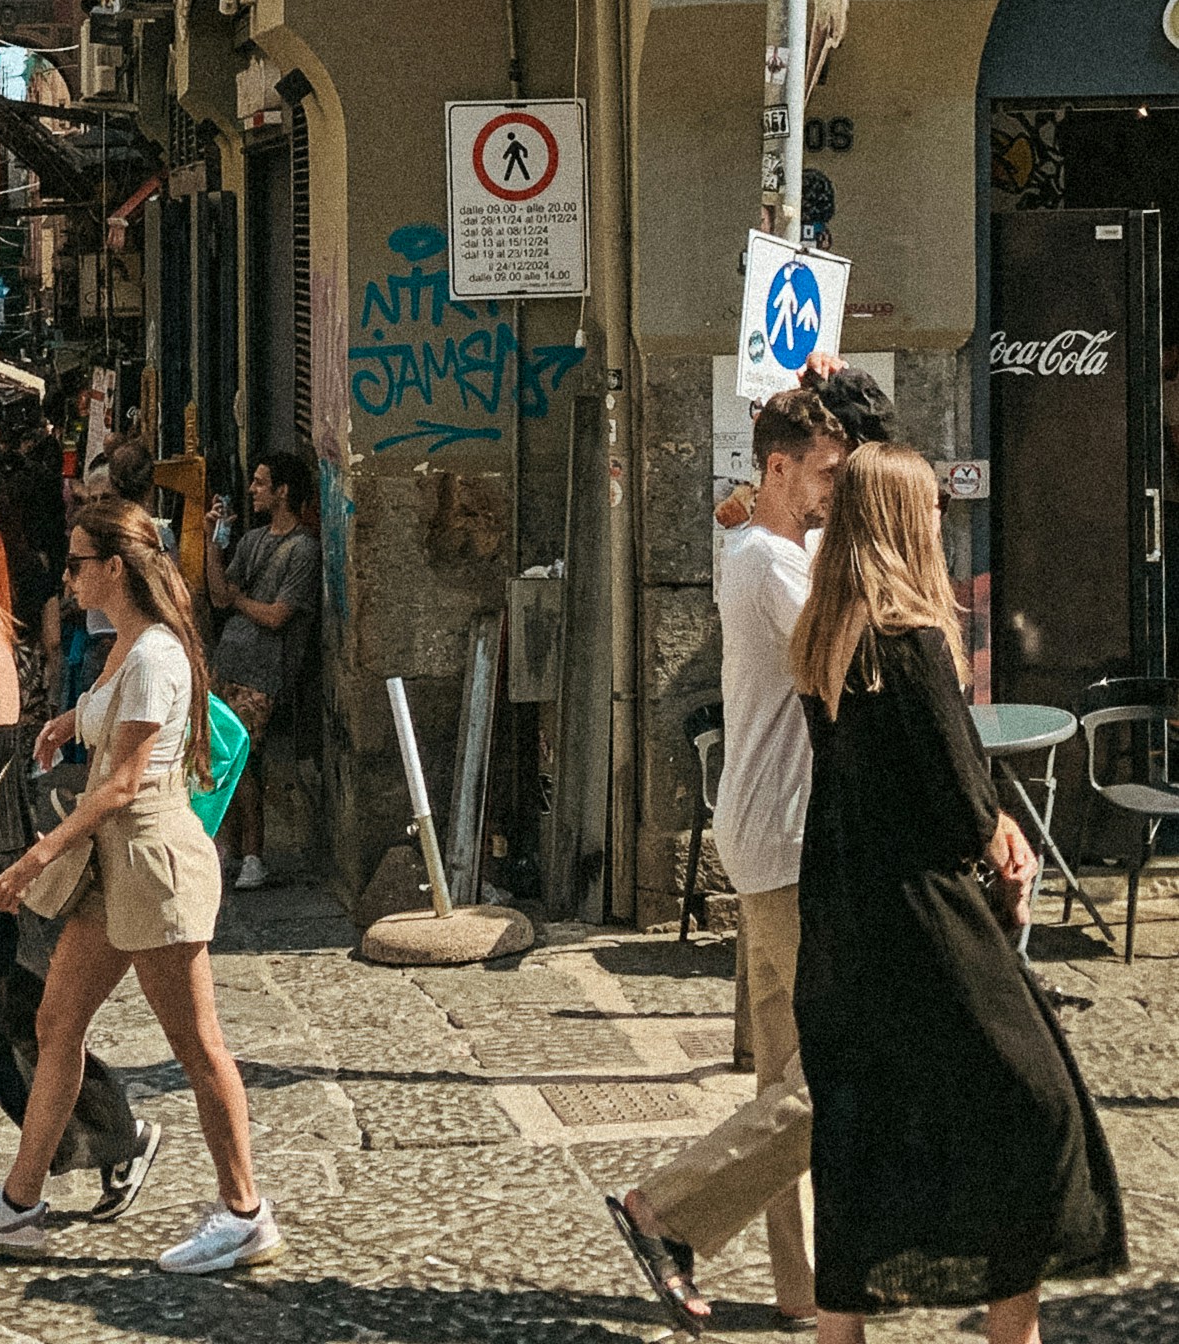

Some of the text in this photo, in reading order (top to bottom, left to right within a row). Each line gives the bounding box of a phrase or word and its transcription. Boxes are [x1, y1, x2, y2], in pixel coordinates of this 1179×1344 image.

[459, 205, 485, 216] dalle
[487, 203, 517, 214] 09.00
[526, 202, 545, 213] alle
[547, 201, 577, 213] 20.00
[525, 214, 534, 224] al
[536, 213, 578, 224] 01/12/24
[496, 226, 505, 236] al
[482, 238, 494, 248] 13
[496, 237, 505, 247] al
[508, 236, 549, 247] 15/12/24
[483, 249, 494, 259] 19
[496, 249, 505, 259] al
[507, 248, 550, 259] 23/12/24
[496, 260, 550, 272] 24/12/2024
[468, 273, 492, 283] dalle
[523, 271, 541, 281] alle
[544, 269, 571, 281] 14.00
